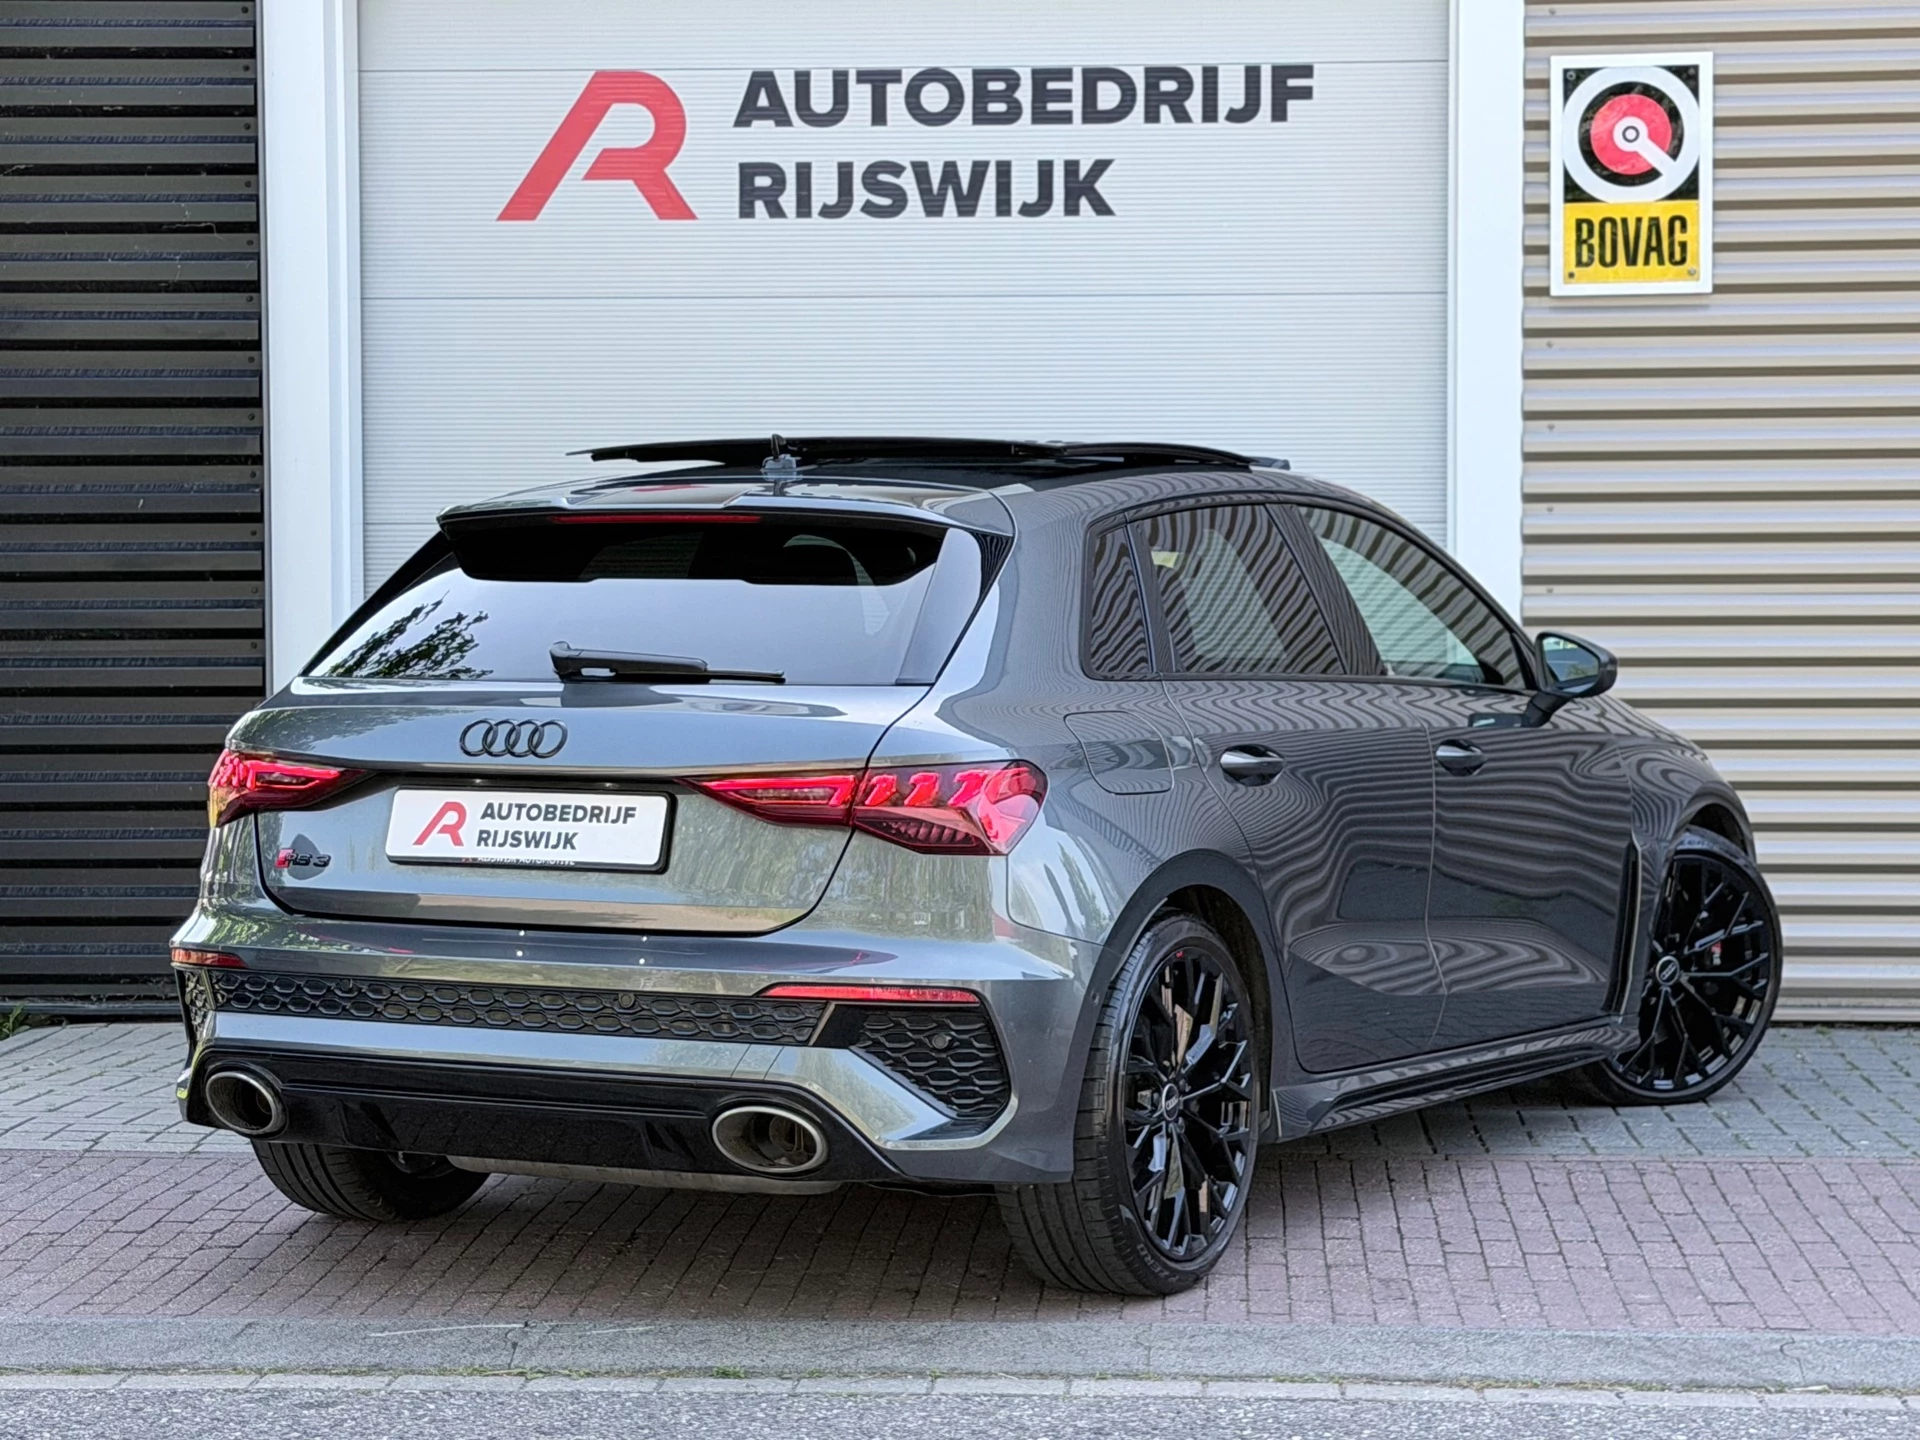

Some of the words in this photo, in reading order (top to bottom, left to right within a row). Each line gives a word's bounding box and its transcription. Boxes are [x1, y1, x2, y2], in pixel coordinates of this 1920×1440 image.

[734, 64, 1314, 127] AUTOBEDRIJF
[738, 159, 1115, 219] RIJSWIJK
[1575, 214, 1688, 268] BOVAG
[476, 830, 578, 851] RIJSWIJK
[480, 802, 637, 825] AUTOBEDRIJF
